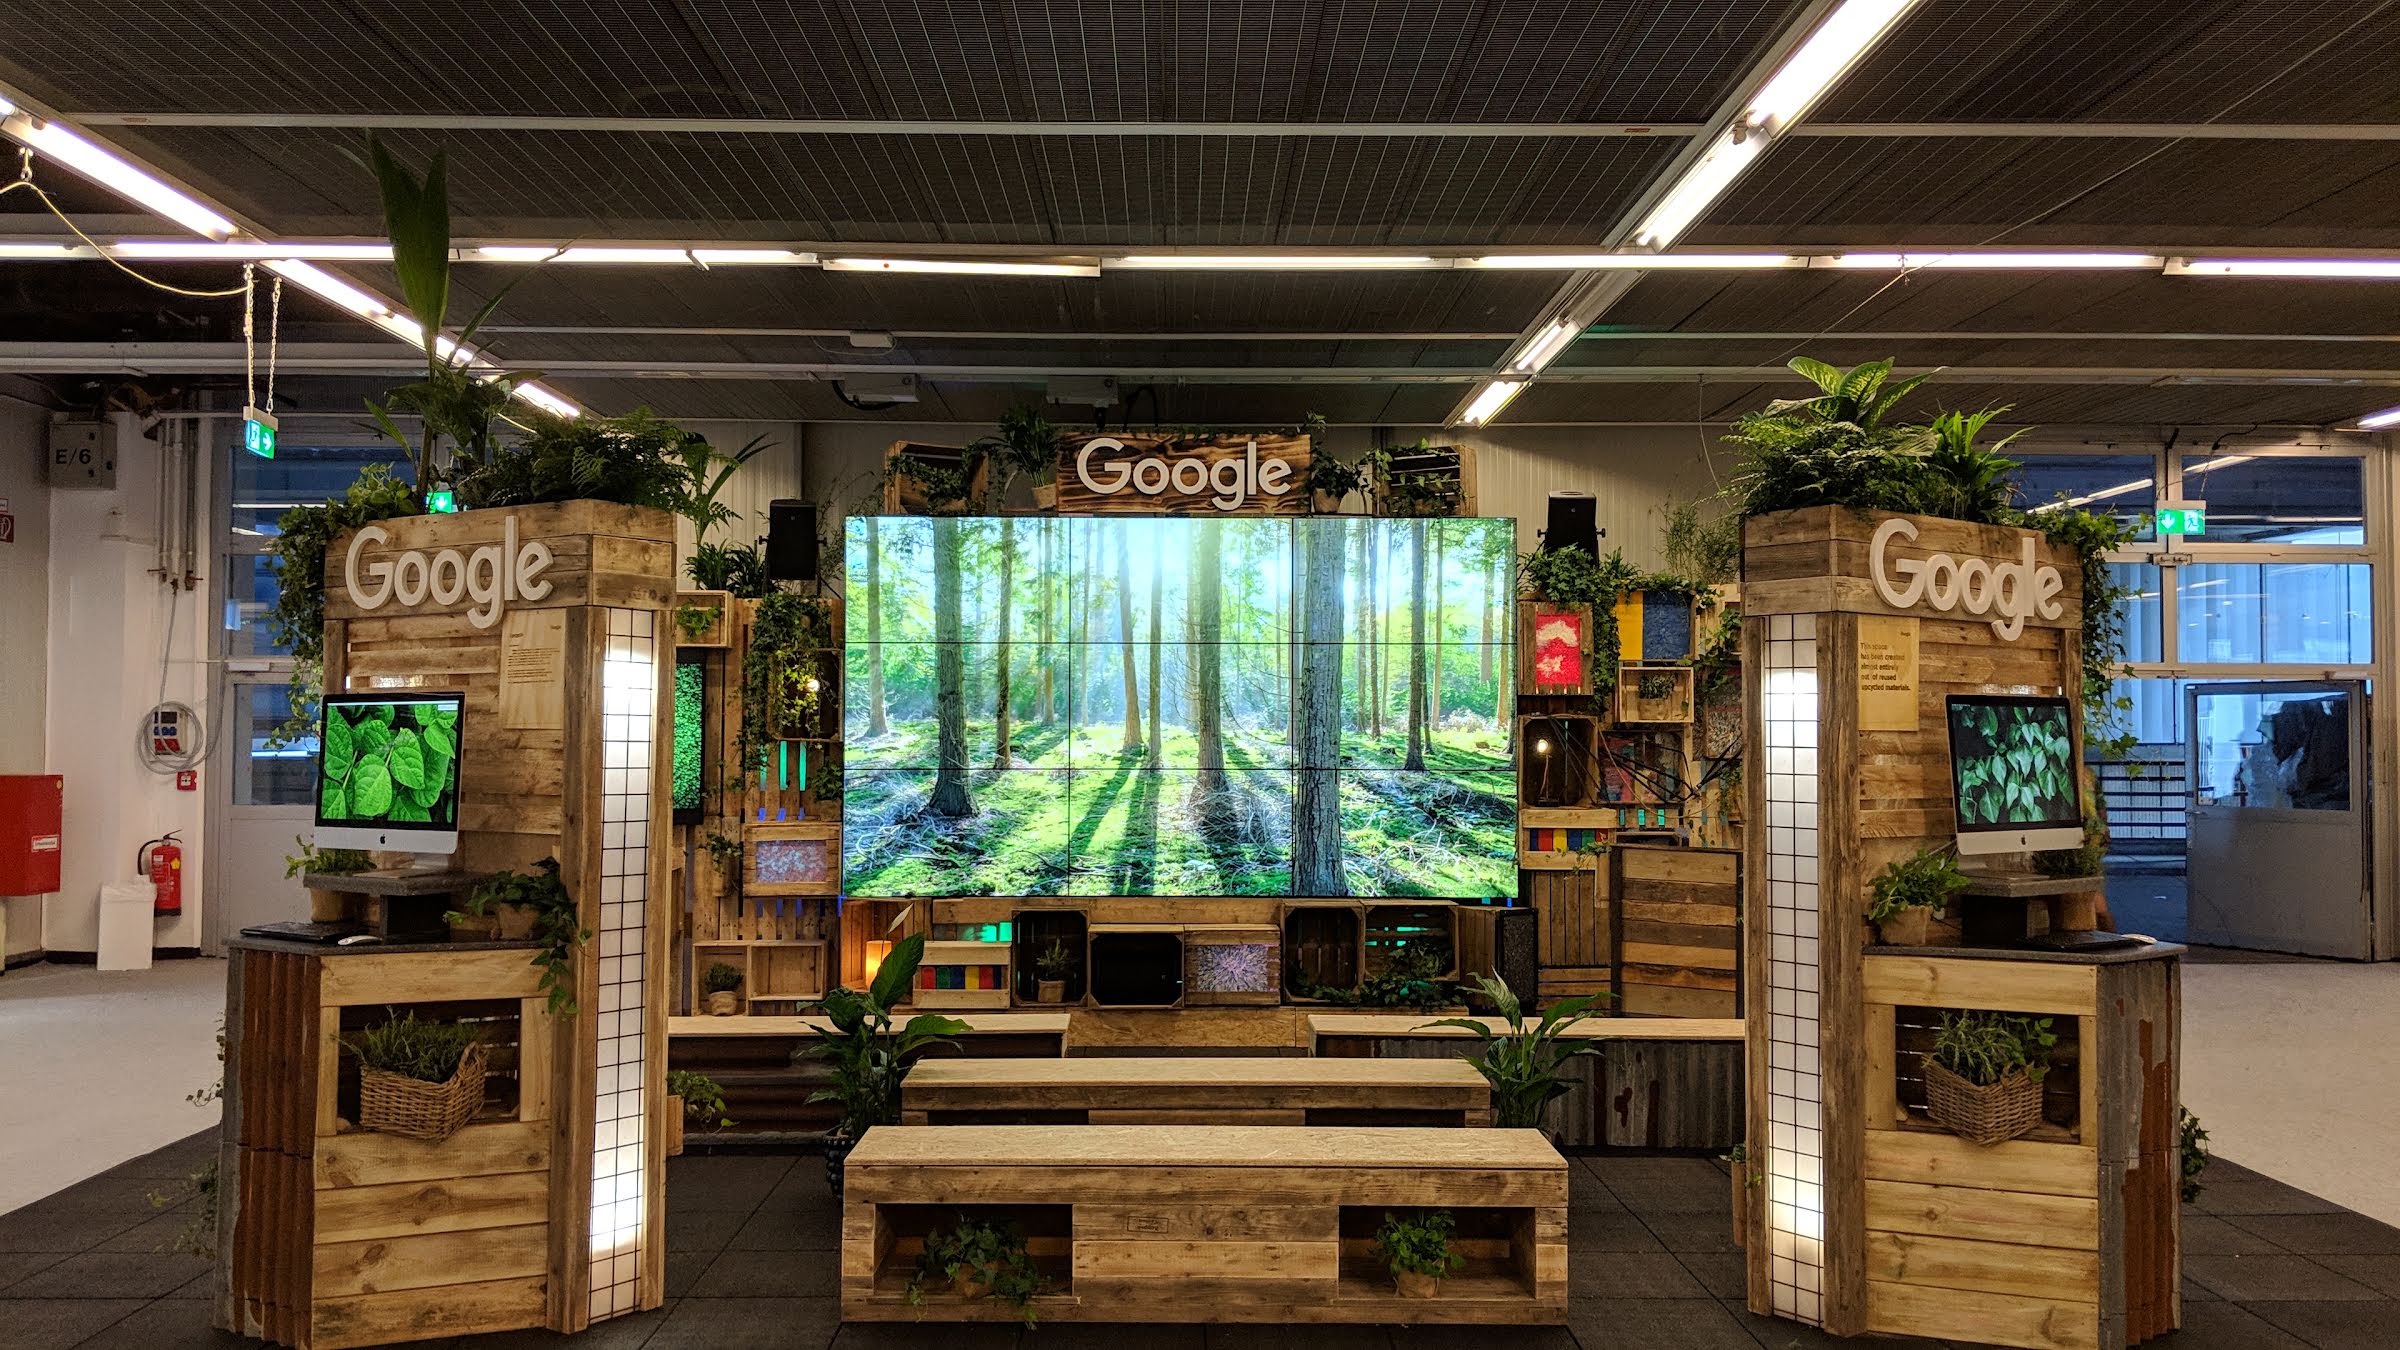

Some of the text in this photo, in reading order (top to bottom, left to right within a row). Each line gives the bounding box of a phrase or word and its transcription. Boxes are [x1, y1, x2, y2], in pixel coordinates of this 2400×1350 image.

[55, 448, 92, 467] E/6
[1077, 438, 1292, 511] Google
[345, 515, 553, 629] Google
[1869, 518, 2063, 641] Google
[1861, 684, 1885, 692] upcycled
[1879, 673, 1897, 681] reused
